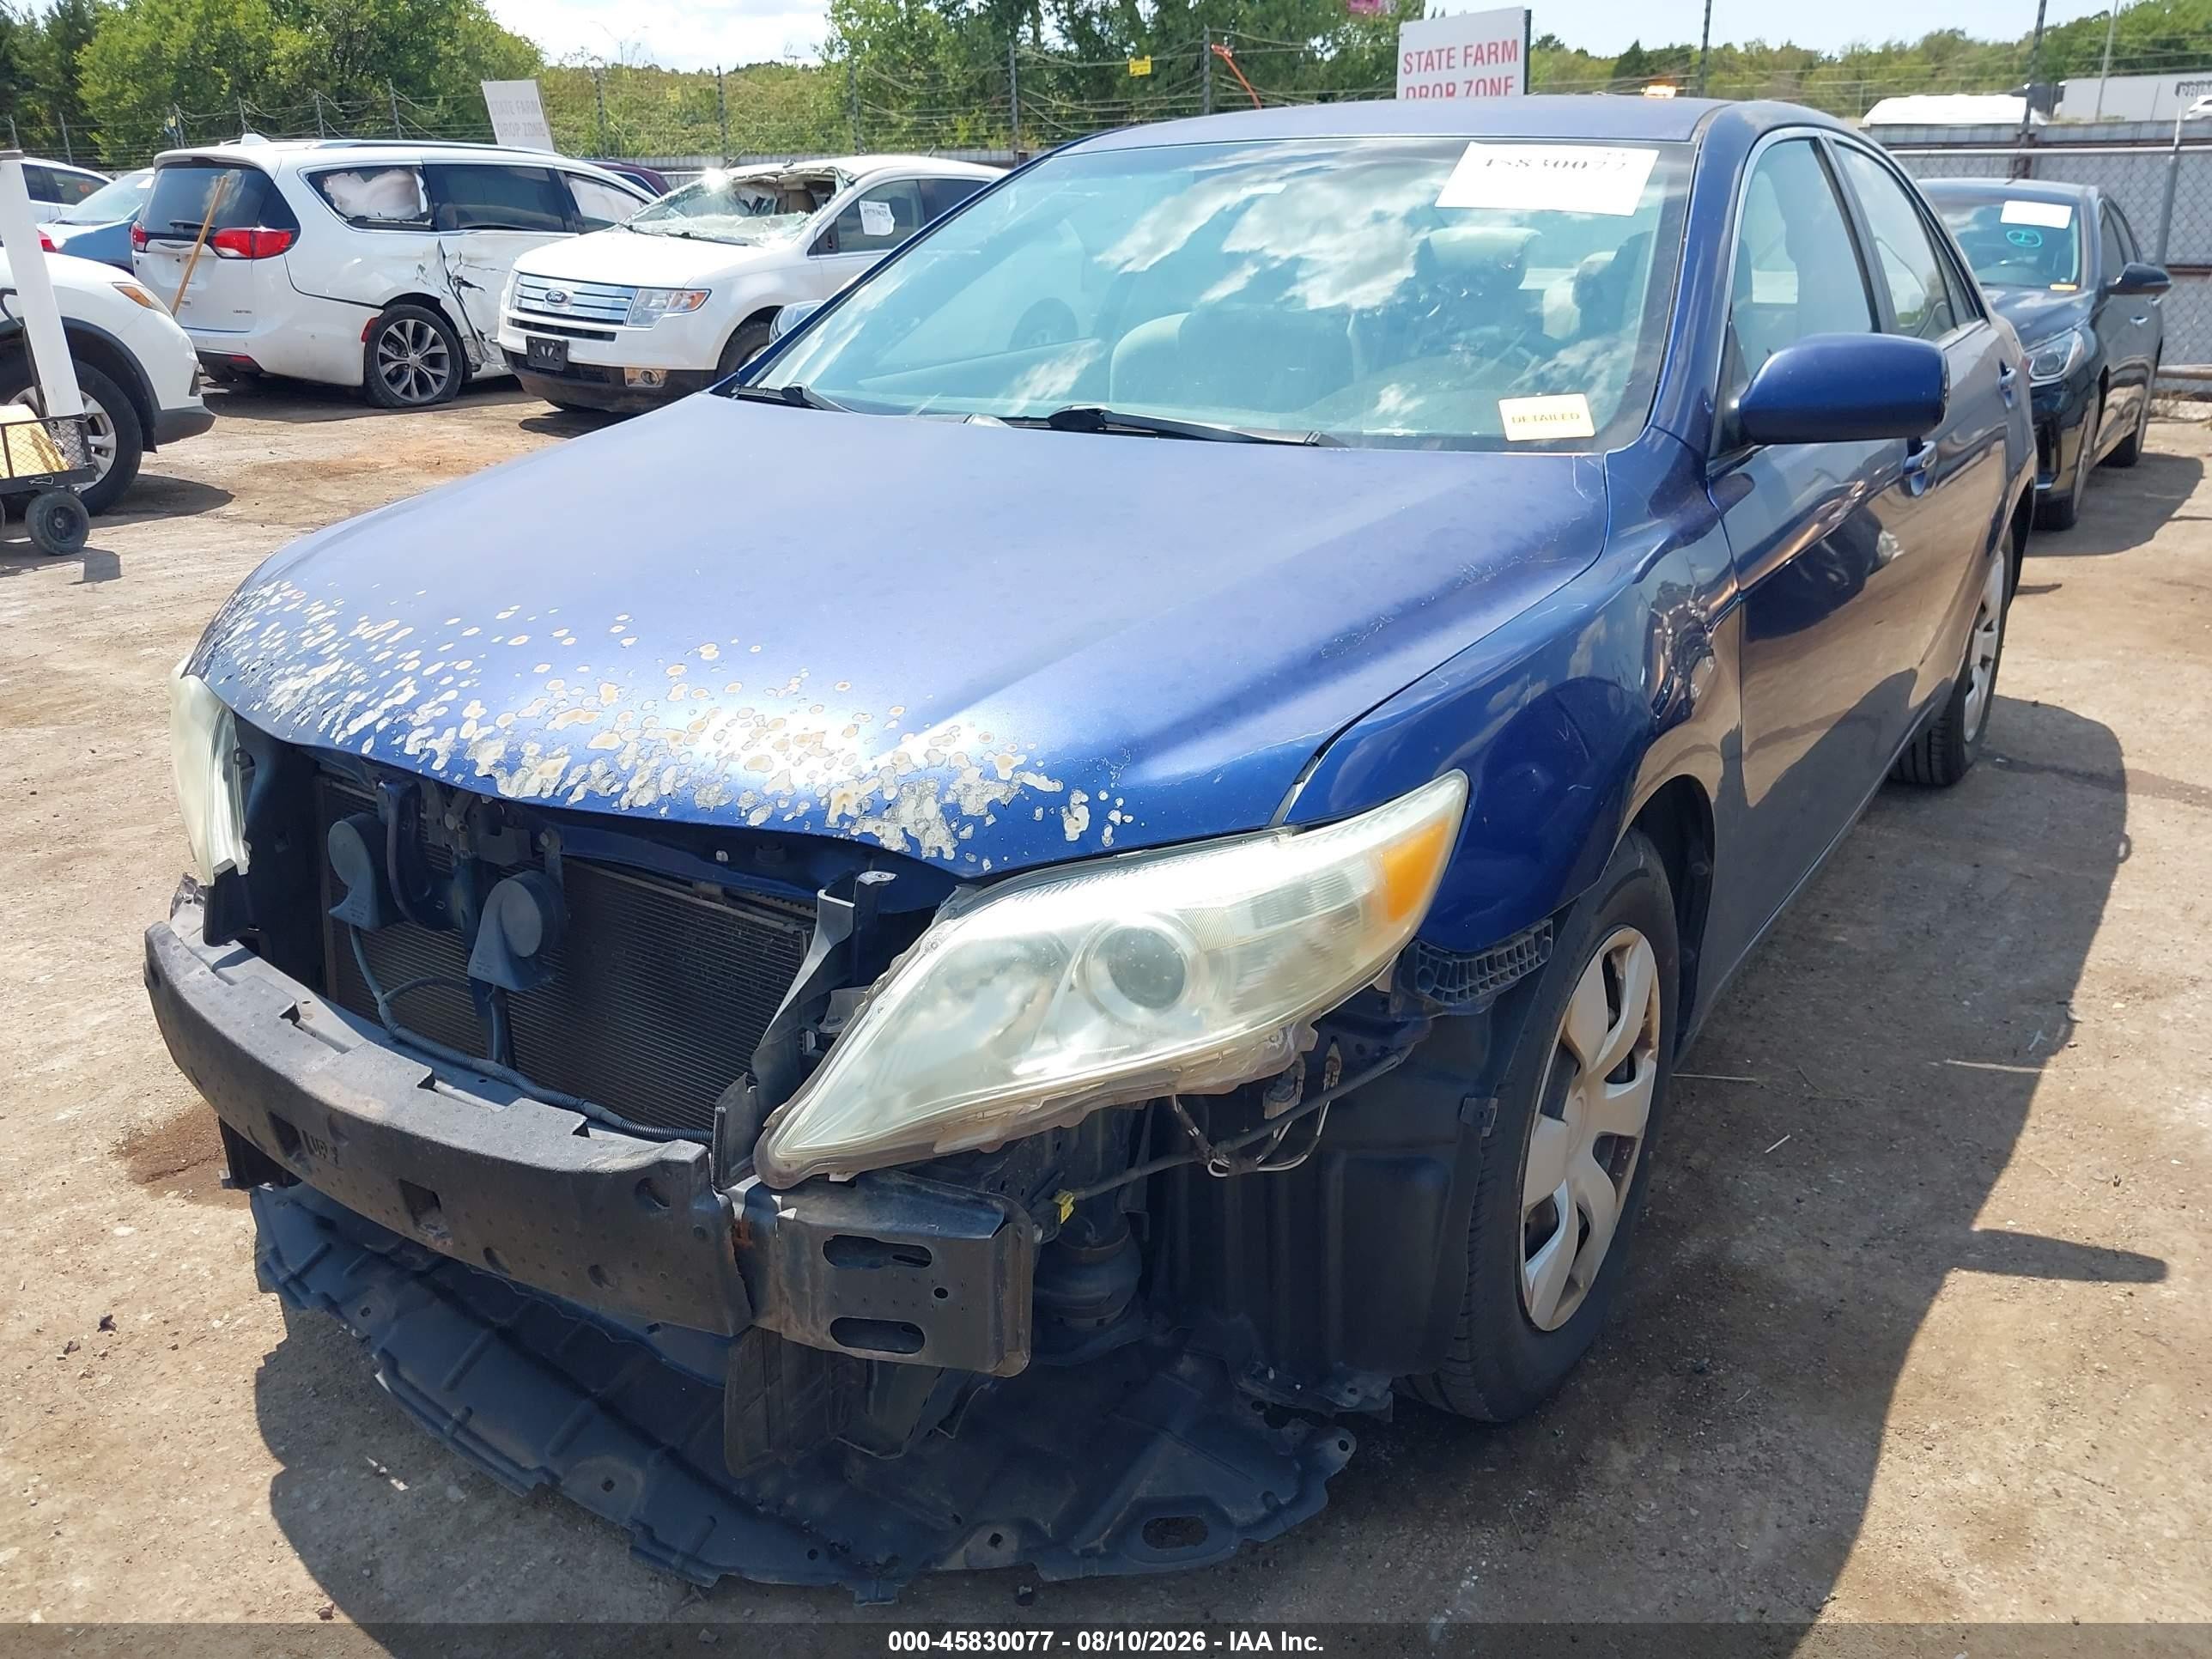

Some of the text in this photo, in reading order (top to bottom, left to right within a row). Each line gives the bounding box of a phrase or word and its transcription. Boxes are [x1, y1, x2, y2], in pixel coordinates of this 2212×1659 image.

[1403, 39, 1518, 75] STATE FARM
[1463, 76, 1514, 97] ZONE
[489, 100, 541, 116] STATE FARM
[496, 122, 546, 137] DROP ZONE
